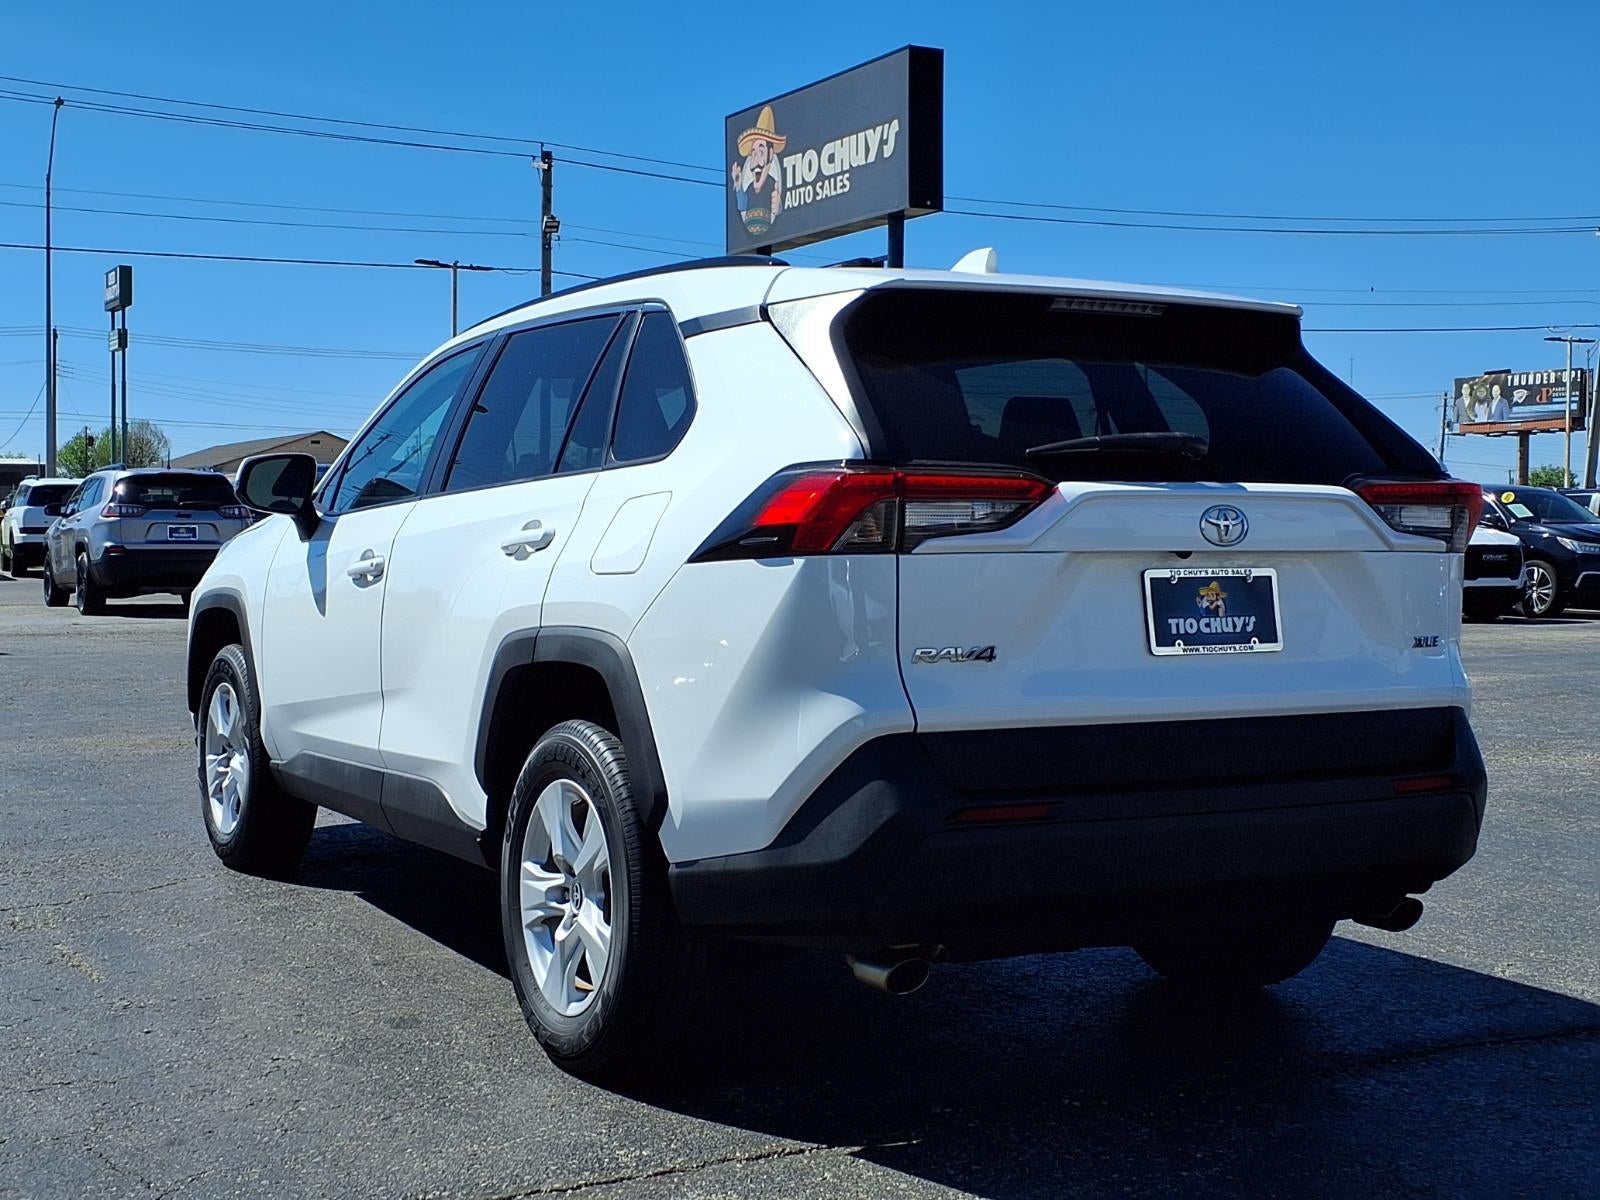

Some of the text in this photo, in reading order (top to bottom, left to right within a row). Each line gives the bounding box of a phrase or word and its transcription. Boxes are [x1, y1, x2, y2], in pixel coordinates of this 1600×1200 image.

[783, 119, 899, 187] TIO CHUY'S
[784, 173, 850, 209] AUTO SALES
[1507, 372, 1555, 386] THUNDER
[1231, 568, 1253, 576] SALES
[1168, 615, 1256, 634] TIO CHUY'S
[1181, 645, 1255, 654] WWW.TIOCHUYS.COM
[1411, 635, 1439, 648] XLE
[911, 645, 997, 664] RAV4
